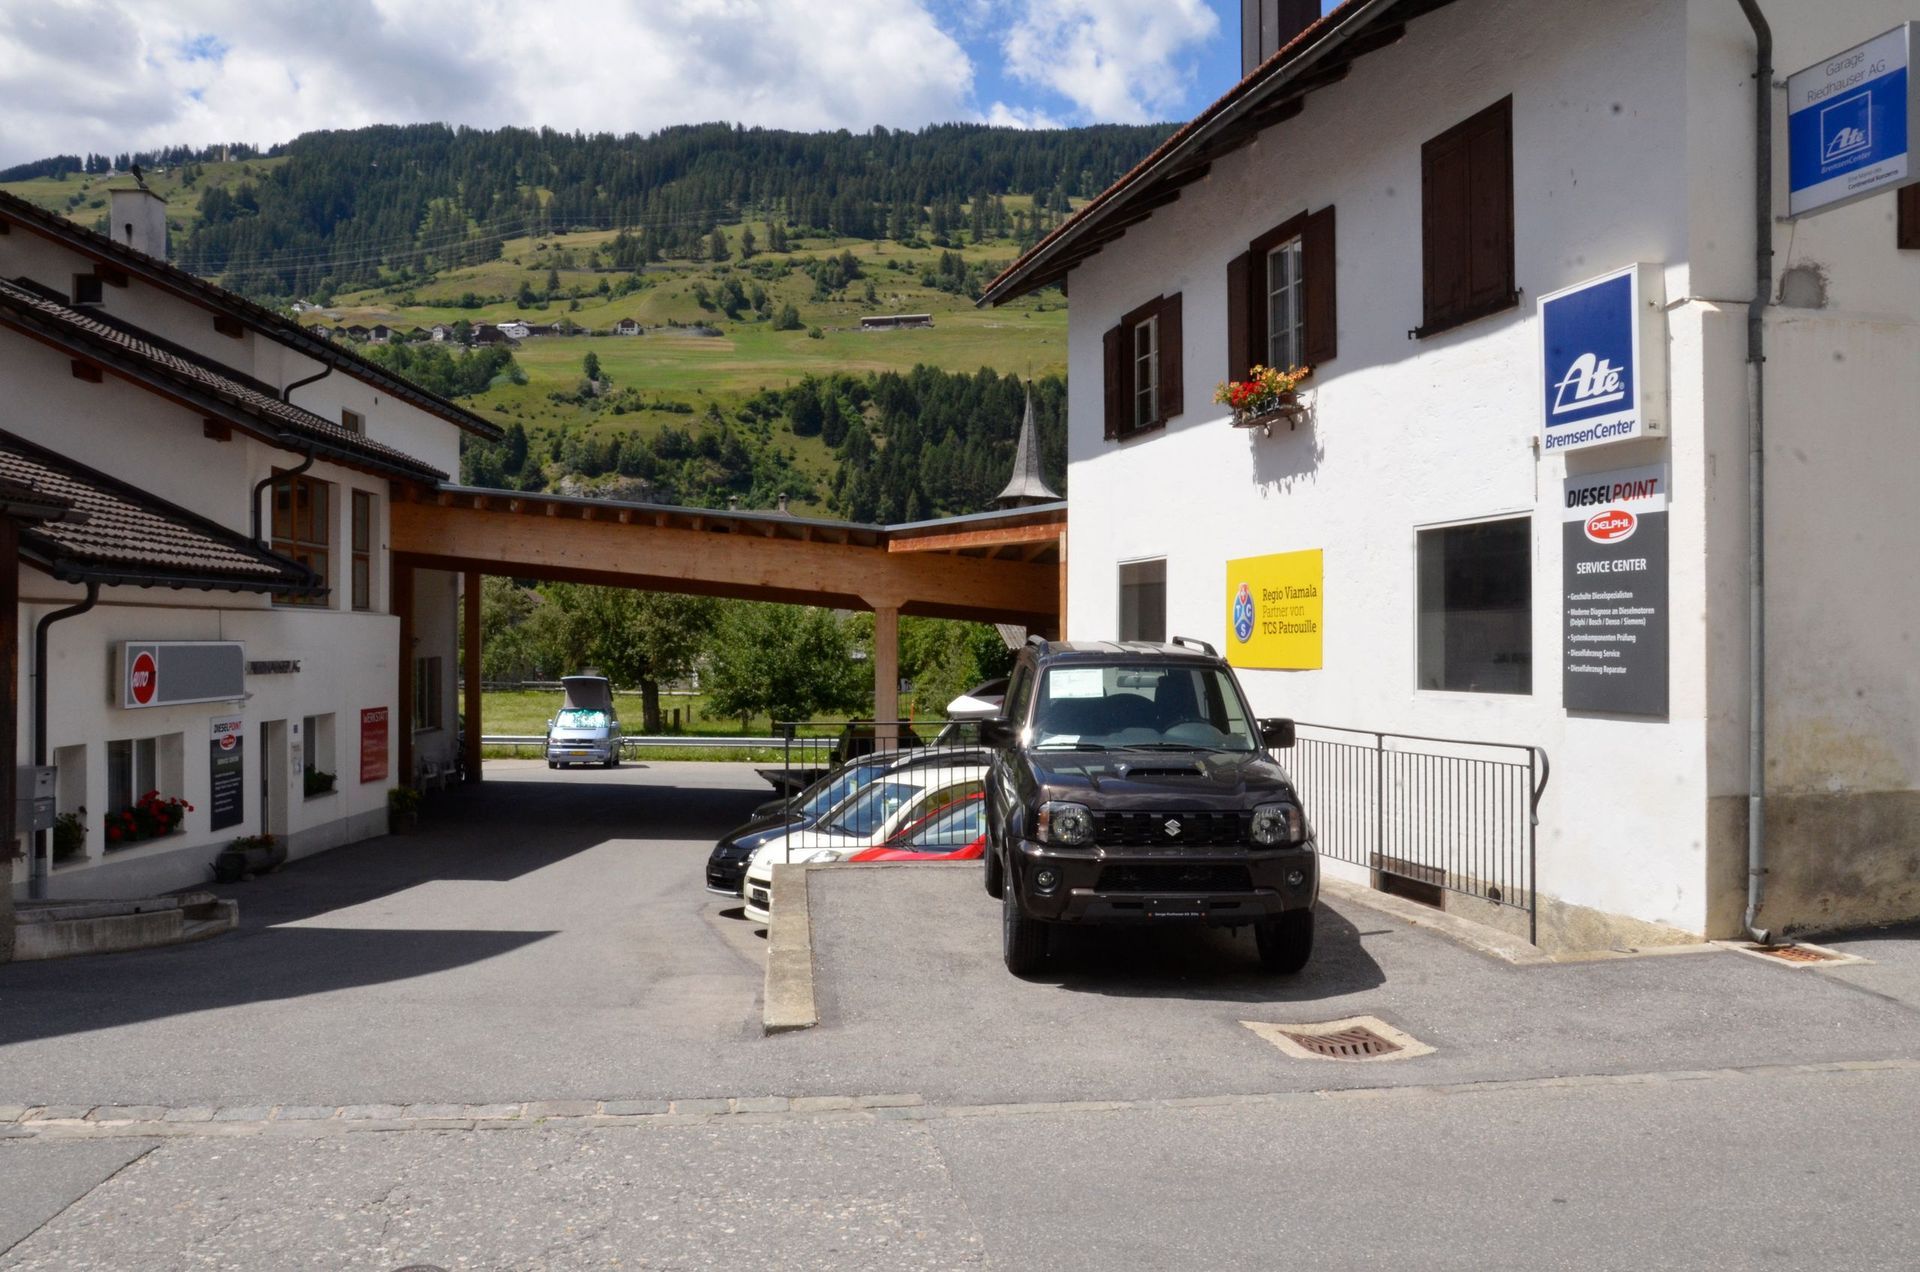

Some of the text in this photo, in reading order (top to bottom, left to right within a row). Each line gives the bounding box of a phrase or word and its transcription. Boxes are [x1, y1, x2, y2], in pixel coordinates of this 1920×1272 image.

[1825, 51, 1865, 77] Garage
[1807, 59, 1886, 103] Riedhauser AG
[1820, 151, 1872, 174] BremsenCenter
[1552, 352, 1624, 415] Ate
[1545, 420, 1636, 449] BremsenCenter
[1566, 478, 1659, 508] DIESELPOINT
[1576, 558, 1647, 574] SERVICE CENTER
[1262, 584, 1317, 604] Regio Viamala
[1262, 605, 1305, 618] Partner von
[1262, 619, 1317, 635] TCS Patrouille
[1603, 649, 1620, 658] Service
